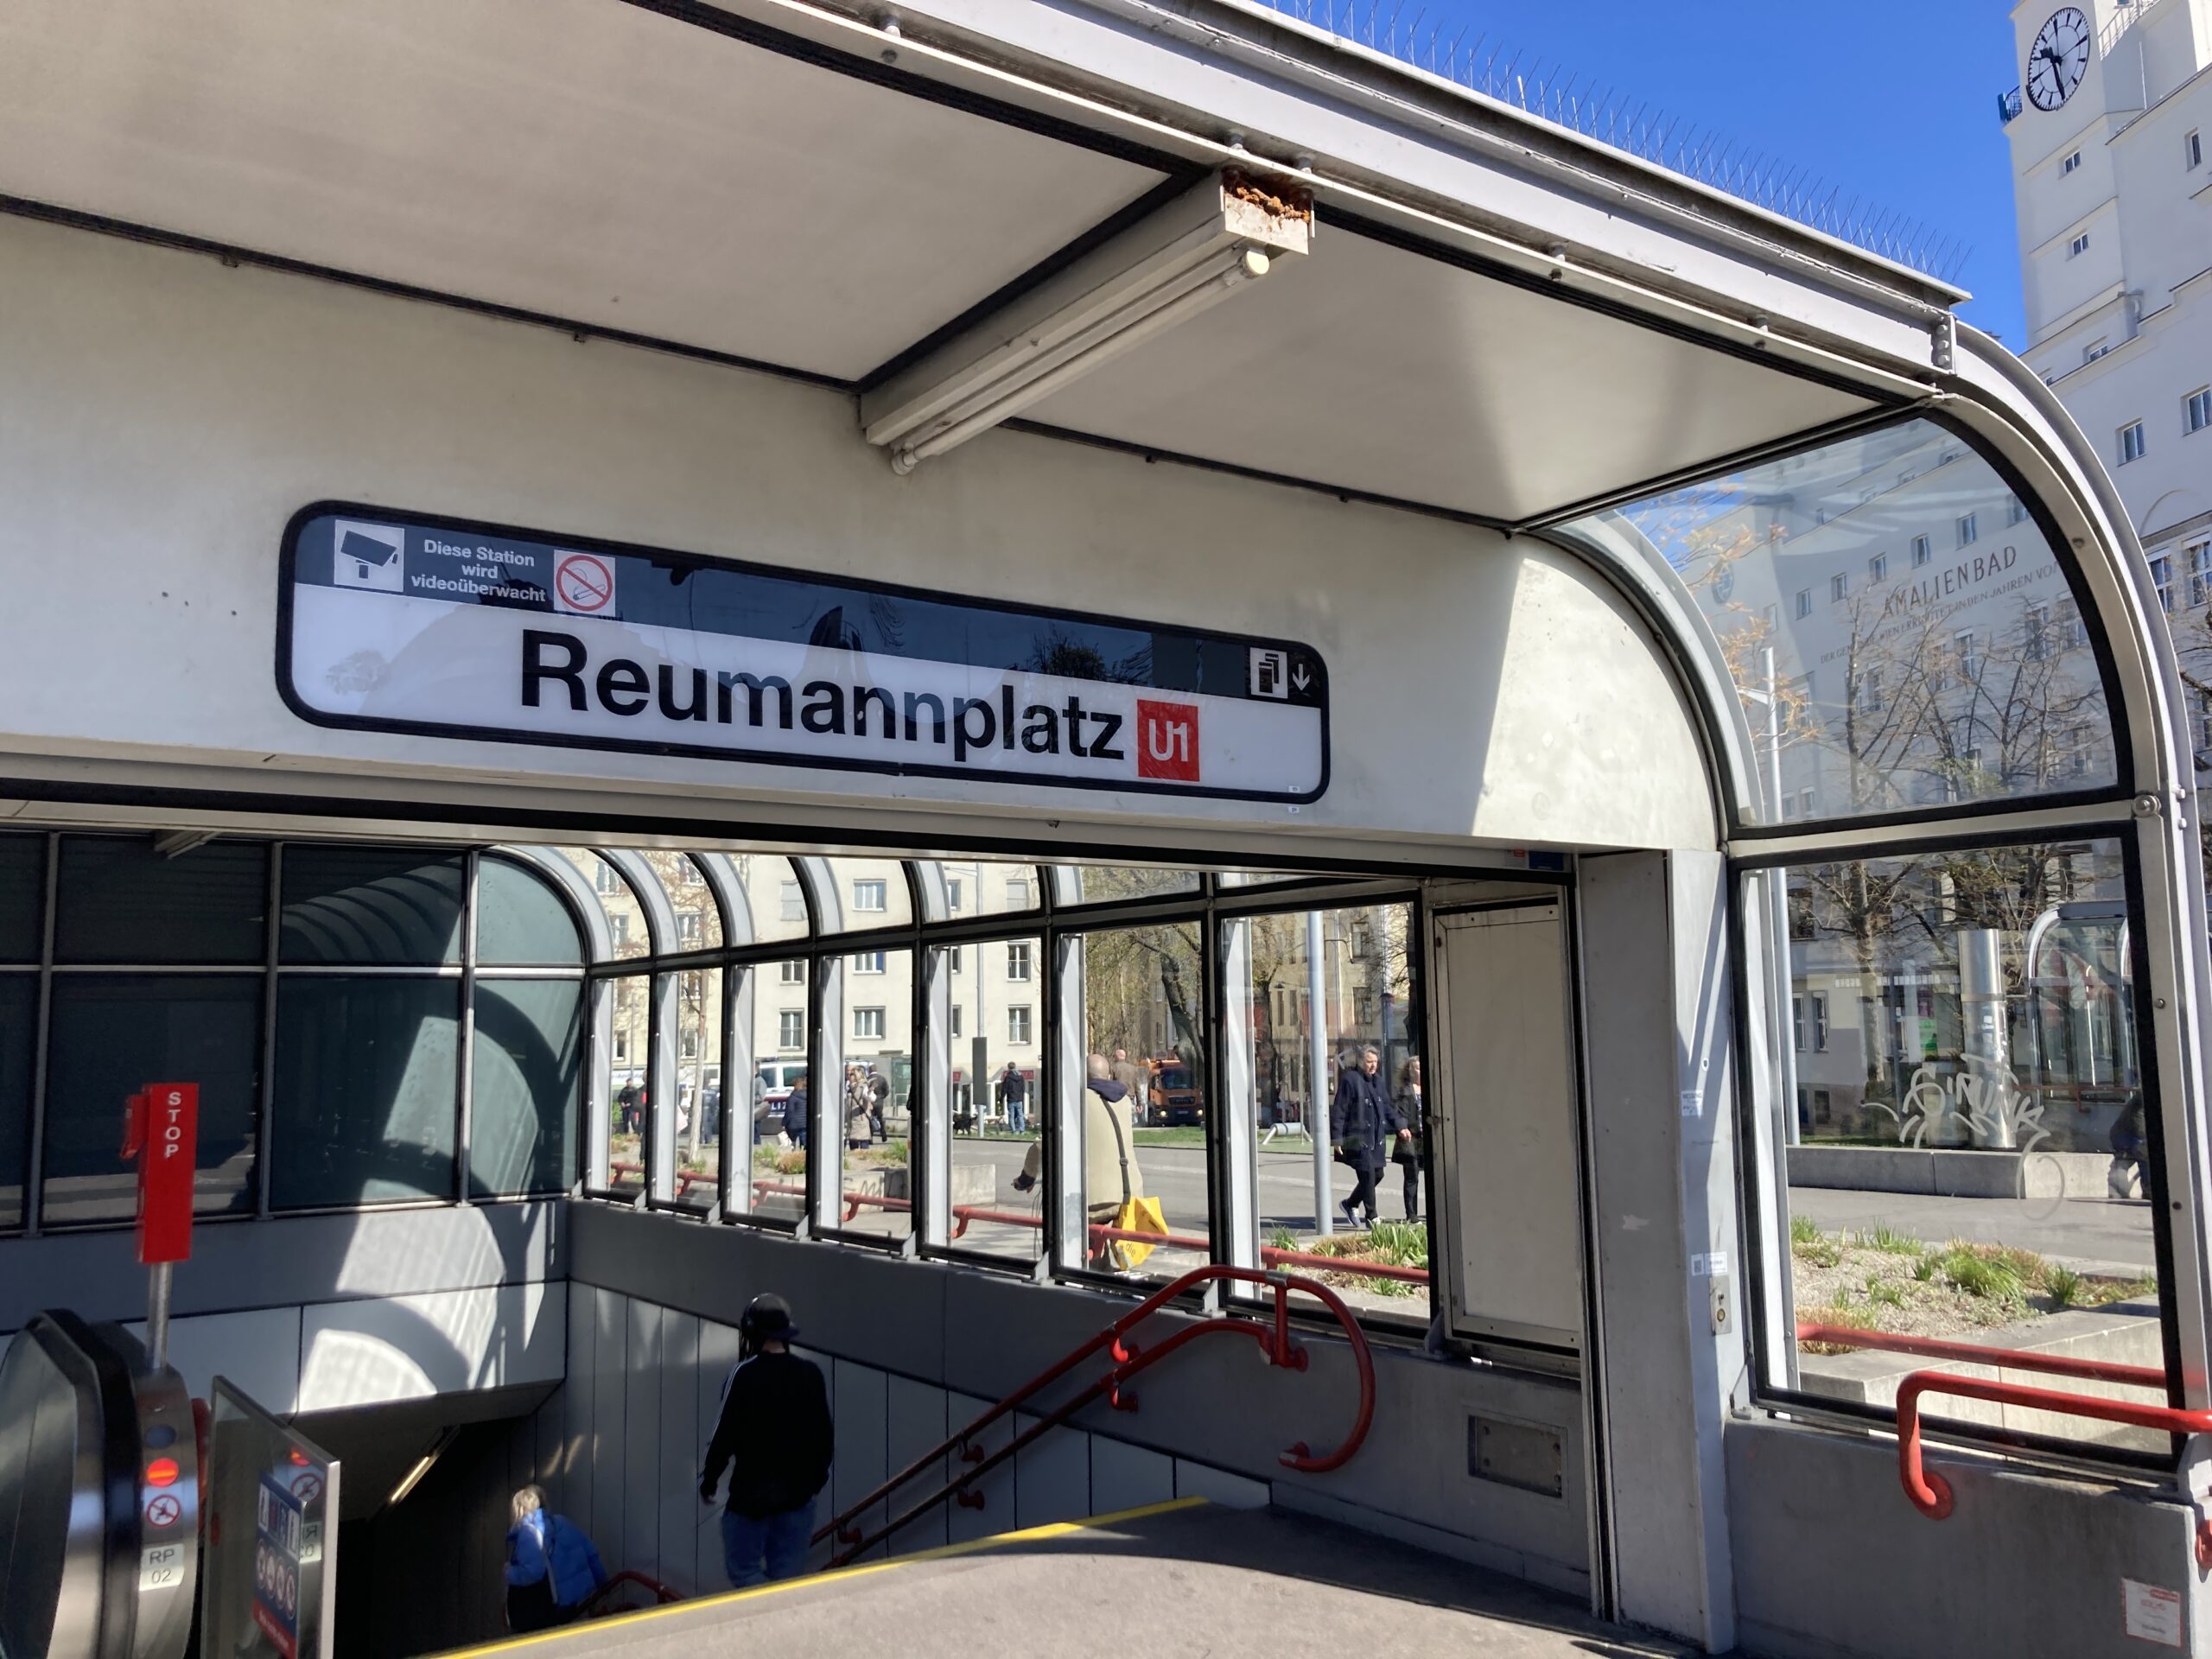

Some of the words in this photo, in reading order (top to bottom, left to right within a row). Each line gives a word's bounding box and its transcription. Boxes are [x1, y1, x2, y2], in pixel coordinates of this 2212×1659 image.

[424, 539, 472, 558] Diese
[476, 546, 535, 567] Station
[461, 564, 499, 579] wird
[1883, 545, 2017, 617] AMALIENBAD
[1990, 572, 2033, 598] JAHREN
[411, 574, 546, 602] videoüberwacht
[521, 628, 1125, 763] Reumannplatz
[1148, 718, 1189, 762] U1
[165, 1091, 181, 1159] STOP
[149, 1548, 175, 1565] RP
[151, 1568, 172, 1584] 02
